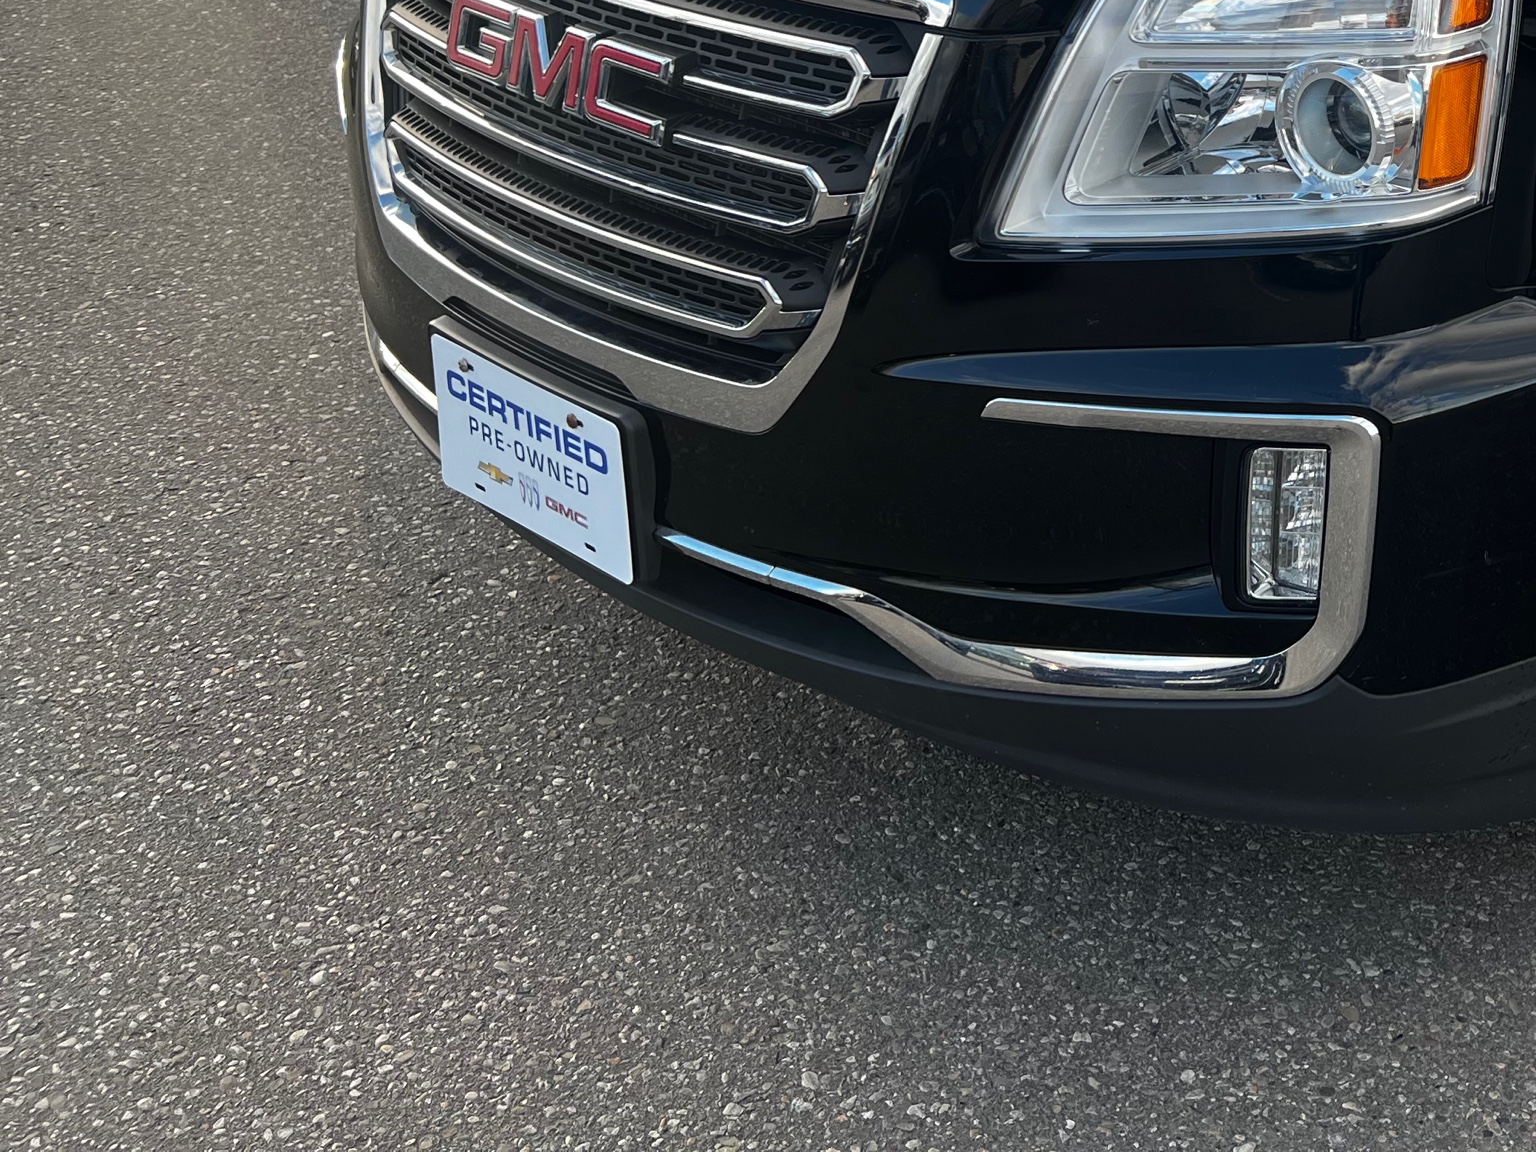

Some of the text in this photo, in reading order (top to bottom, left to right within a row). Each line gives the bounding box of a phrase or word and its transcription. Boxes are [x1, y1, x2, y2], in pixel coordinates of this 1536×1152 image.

[446, 369, 609, 475] CERTIFIED
[468, 415, 590, 496] PRE-OWNED
[545, 496, 589, 529] GMC
